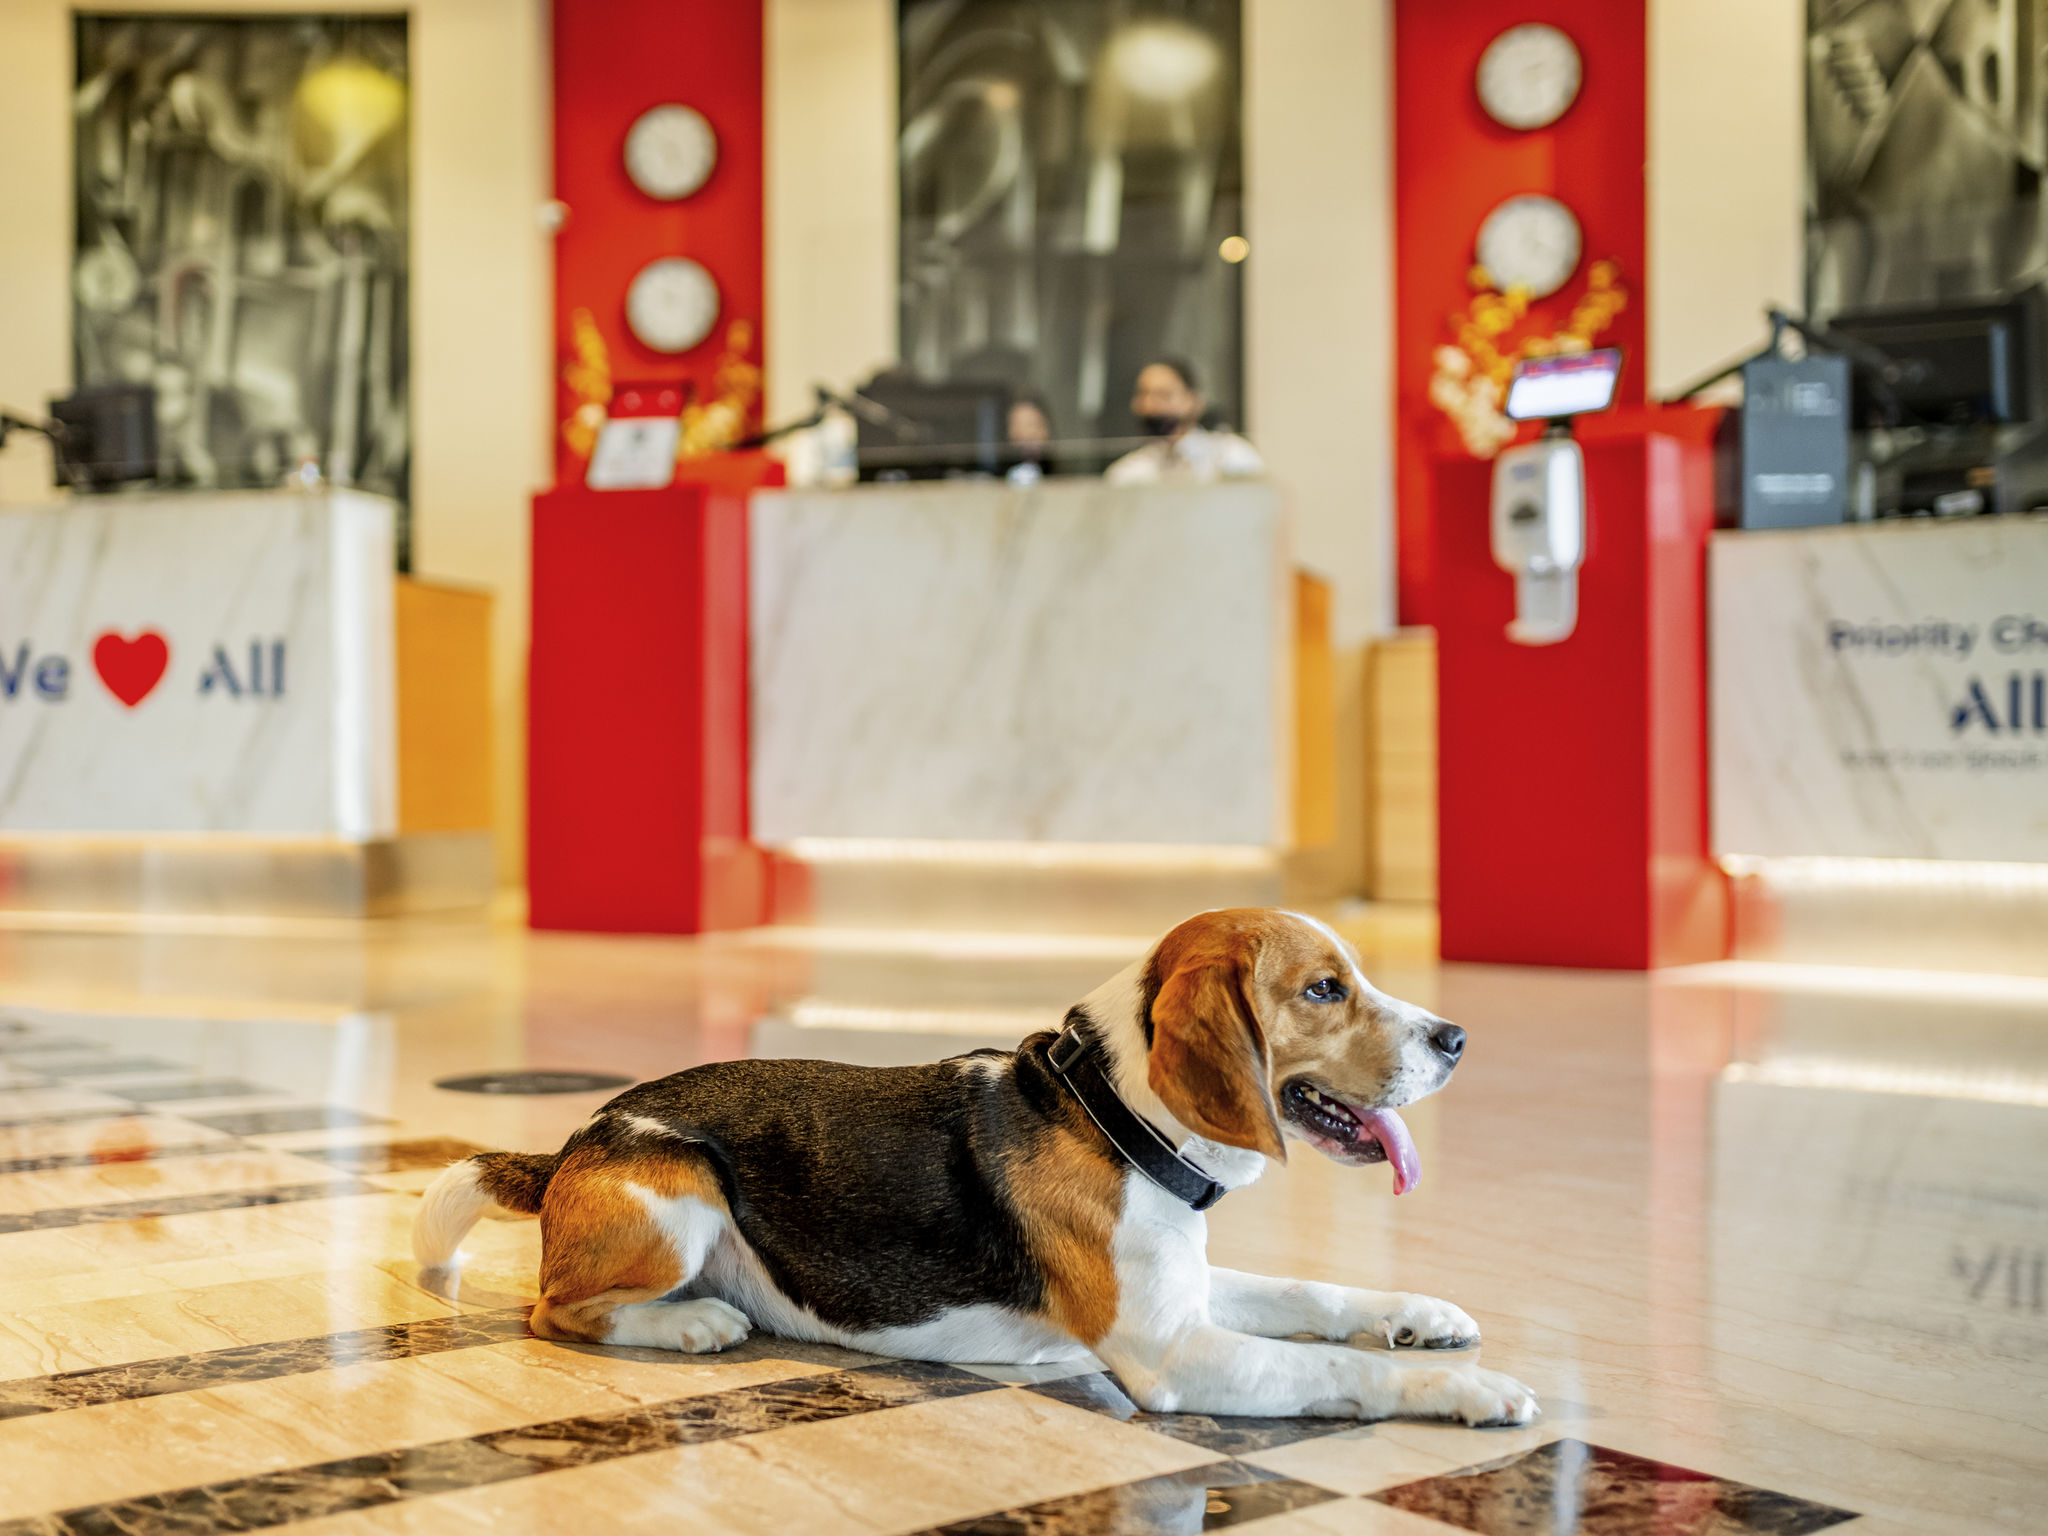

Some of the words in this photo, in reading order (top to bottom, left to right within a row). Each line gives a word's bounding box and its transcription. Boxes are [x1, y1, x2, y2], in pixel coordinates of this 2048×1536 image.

[197, 637, 286, 698] All
[1829, 615, 1978, 661] Priority
[1950, 670, 2047, 736] All
